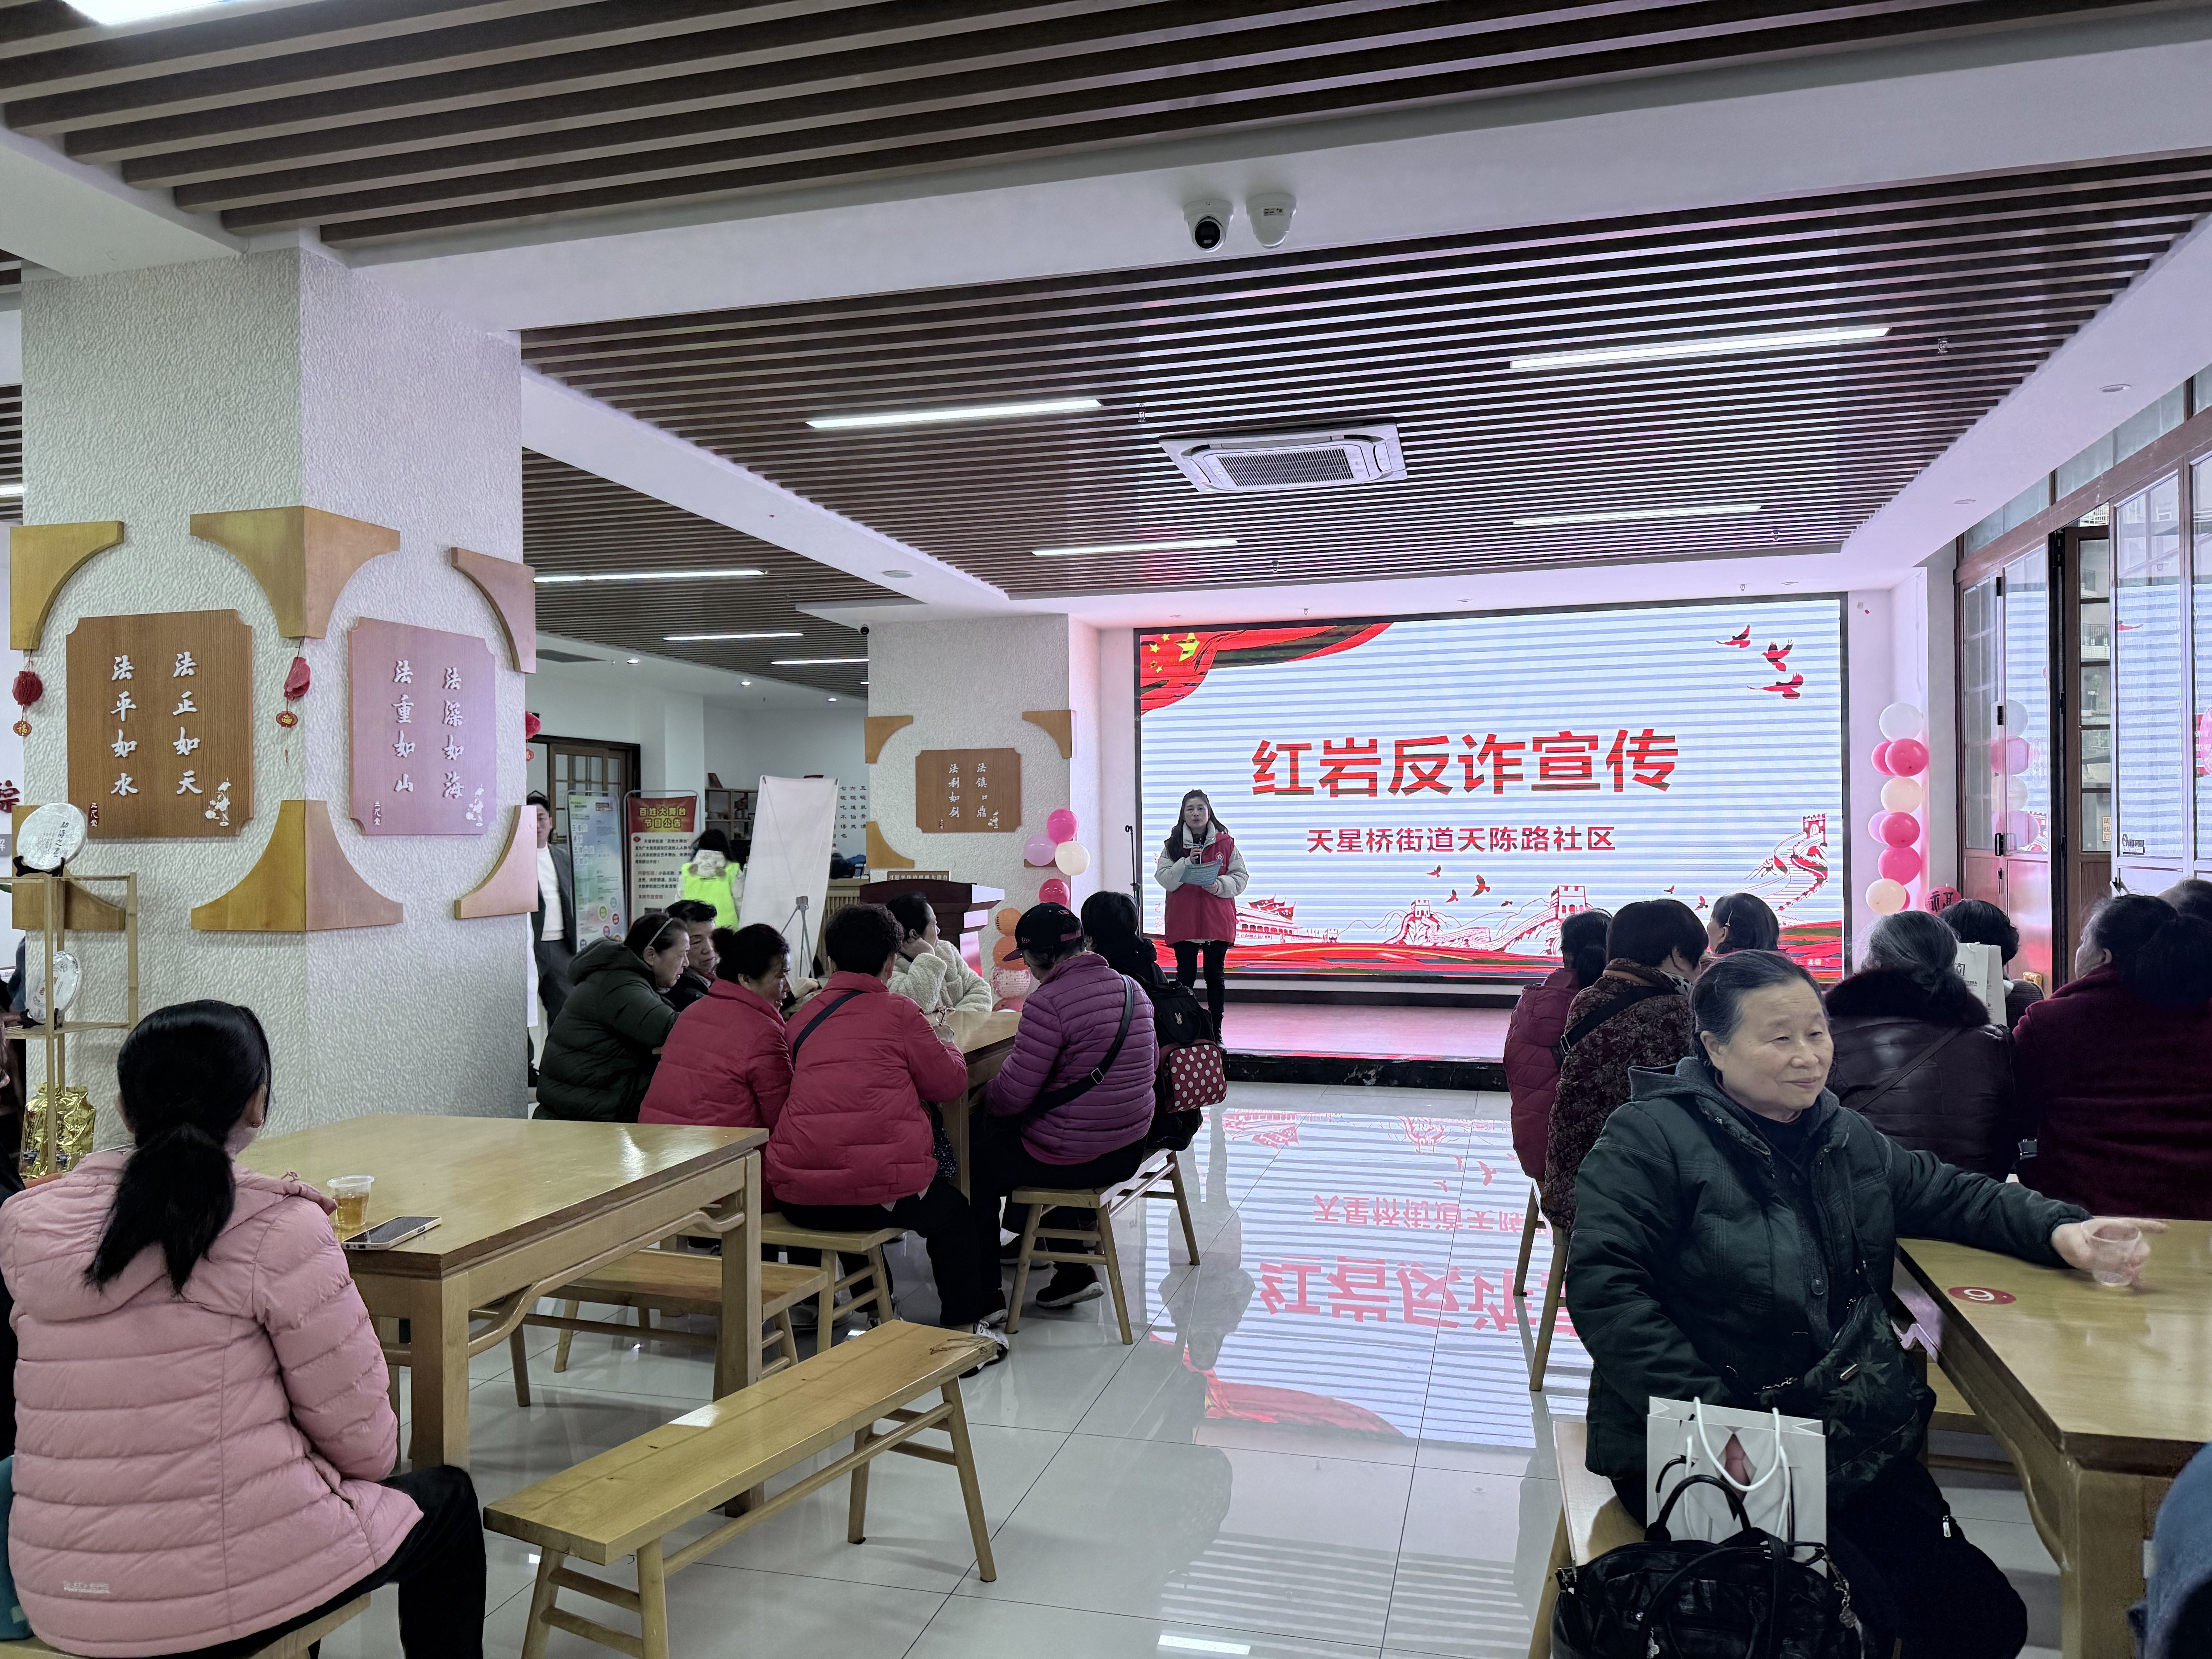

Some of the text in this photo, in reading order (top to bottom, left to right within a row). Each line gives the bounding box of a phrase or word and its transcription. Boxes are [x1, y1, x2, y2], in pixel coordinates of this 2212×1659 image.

[110, 655, 139, 796] 法平如水
[173, 651, 203, 795] 法正如天
[392, 660, 416, 792] 法重如山
[443, 667, 464, 799] 法深如海
[948, 764, 960, 817] 法利如剑
[1252, 728, 1679, 797] 红岩反诈宣传
[639, 807, 686, 816] 百姓大舞台
[644, 819, 682, 828] 节目公告
[1307, 826, 1616, 854] 天星桥街道天陈路社区
